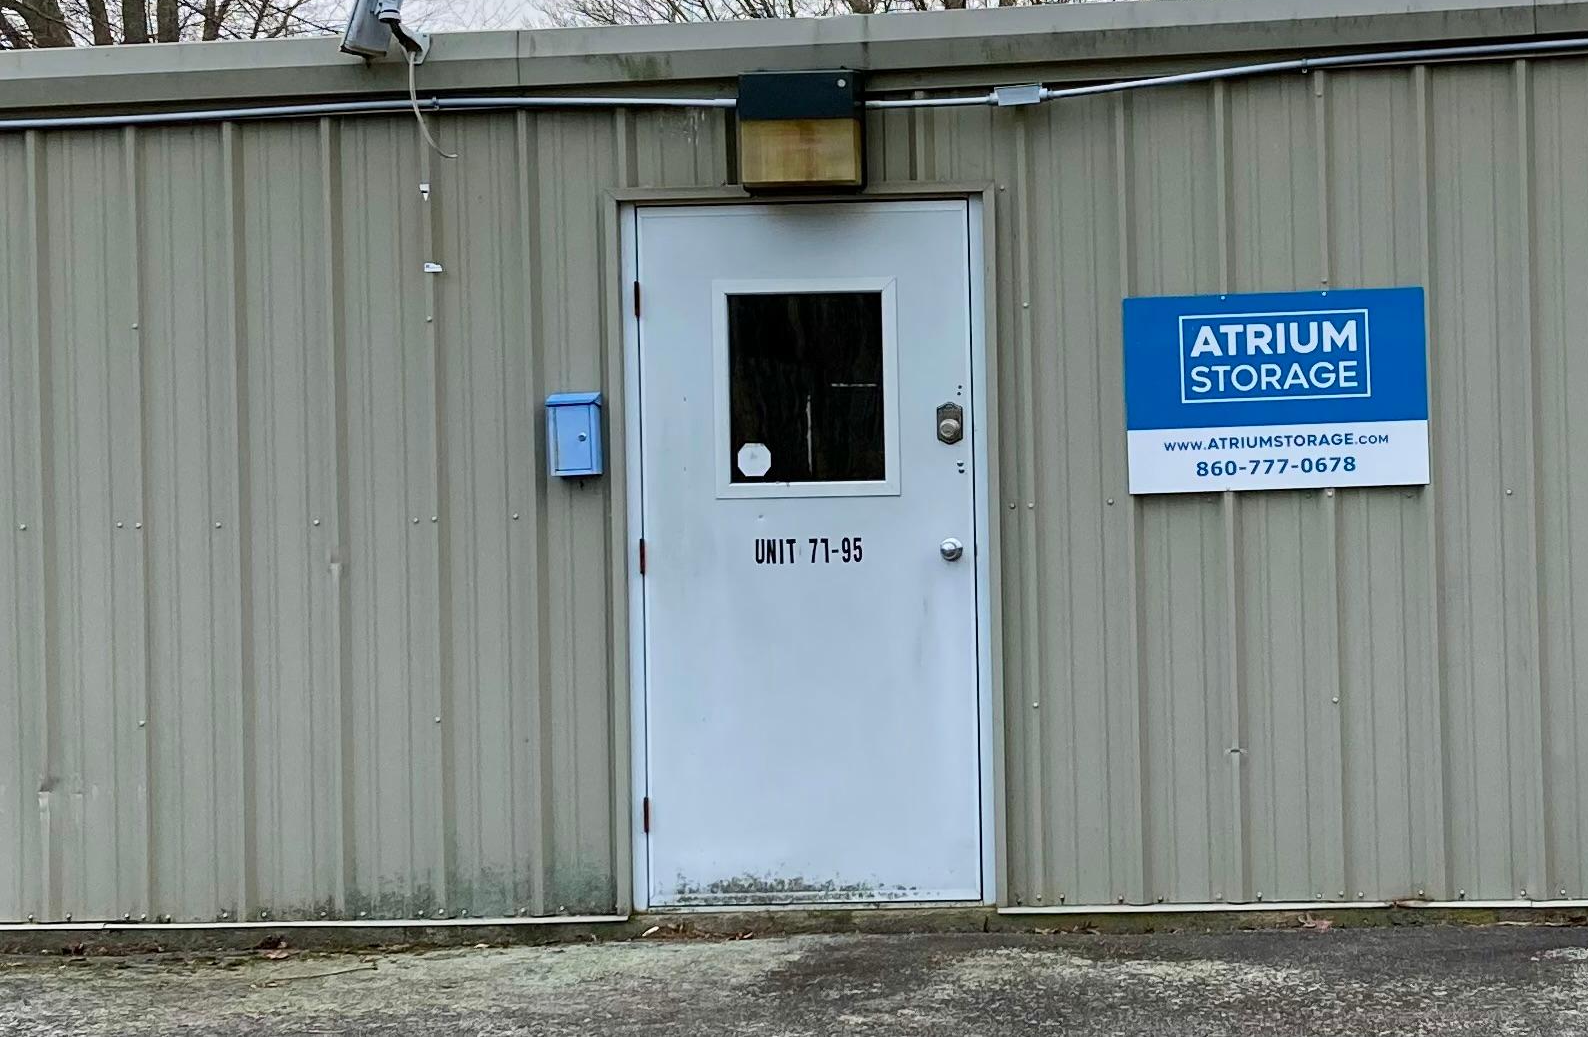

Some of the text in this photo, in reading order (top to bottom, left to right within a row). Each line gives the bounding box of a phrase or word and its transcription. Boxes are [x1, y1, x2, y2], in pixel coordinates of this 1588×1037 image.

[1190, 319, 1357, 357] ATRIUM
[1191, 360, 1358, 393] STORAGE
[1196, 455, 1357, 477] 860-777-0678
[755, 538, 797, 565] UNIT
